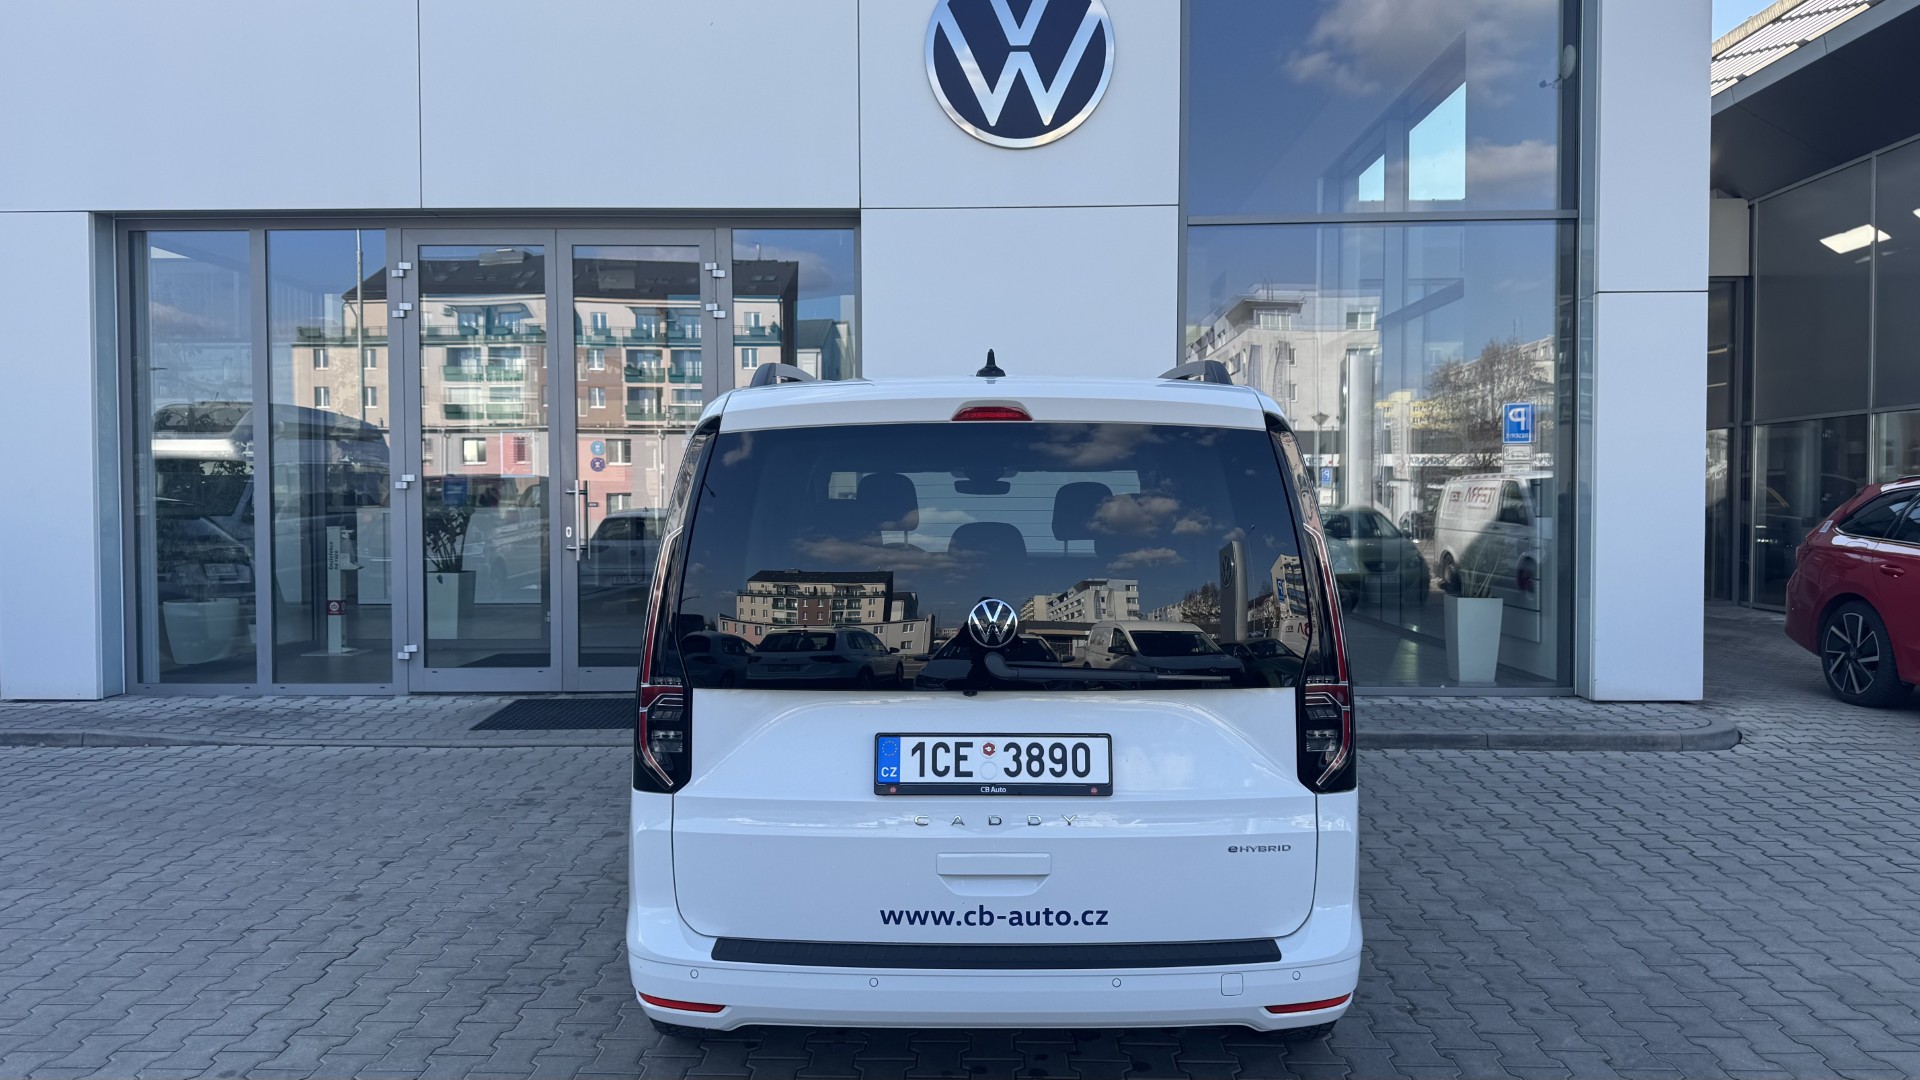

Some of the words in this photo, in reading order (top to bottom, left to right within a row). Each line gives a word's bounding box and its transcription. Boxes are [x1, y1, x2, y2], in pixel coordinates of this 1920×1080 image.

[911, 741, 974, 778] 1CE
[1003, 741, 1091, 778] 3890
[881, 767, 898, 778] CZ
[913, 814, 1078, 827] CADDY
[1227, 844, 1292, 853] eHYBRID
[879, 905, 1110, 927] www.cb-auto.cz
